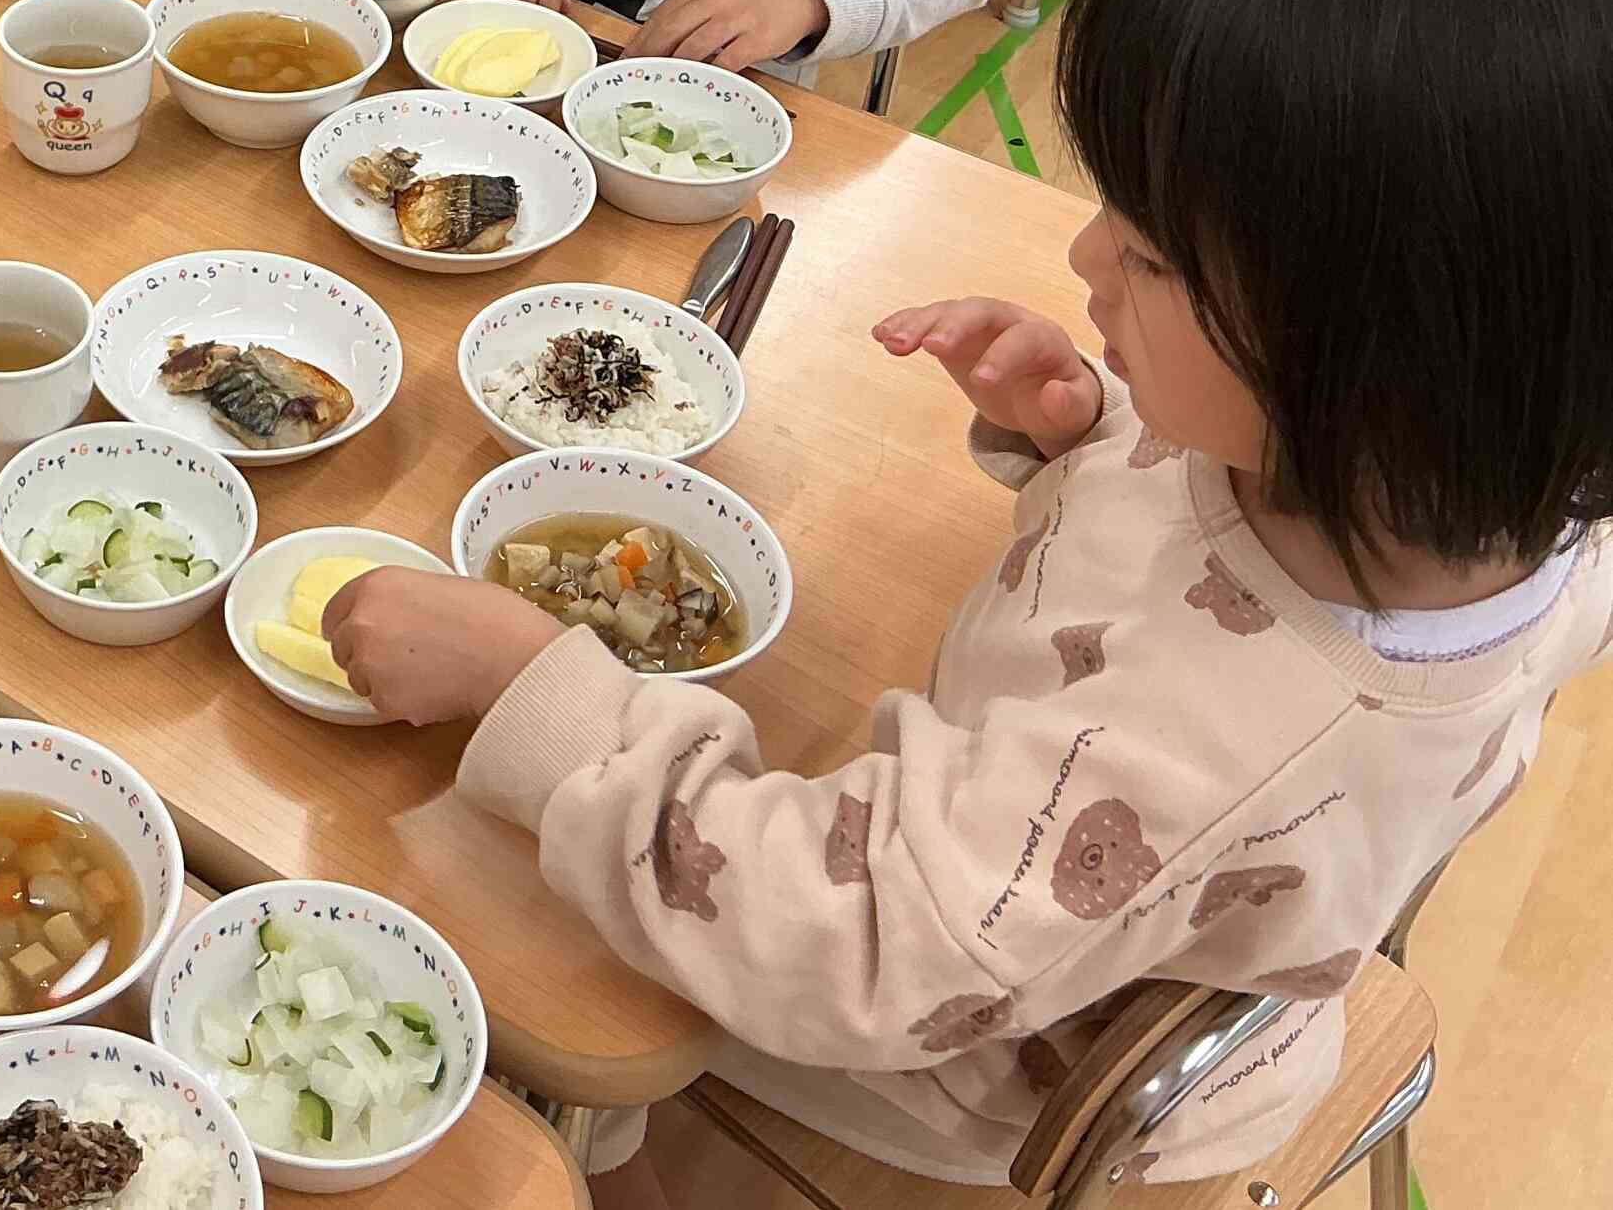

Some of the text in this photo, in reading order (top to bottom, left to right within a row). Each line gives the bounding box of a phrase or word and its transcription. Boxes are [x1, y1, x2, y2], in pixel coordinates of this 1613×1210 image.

[679, 73, 691, 84] Q
[43, 81, 67, 102] Q
[46, 140, 92, 151] queen
[330, 907, 341, 920] K
[424, 954, 435, 971] N
[25, 1049, 39, 1064] K
[150, 1071, 165, 1086] N
